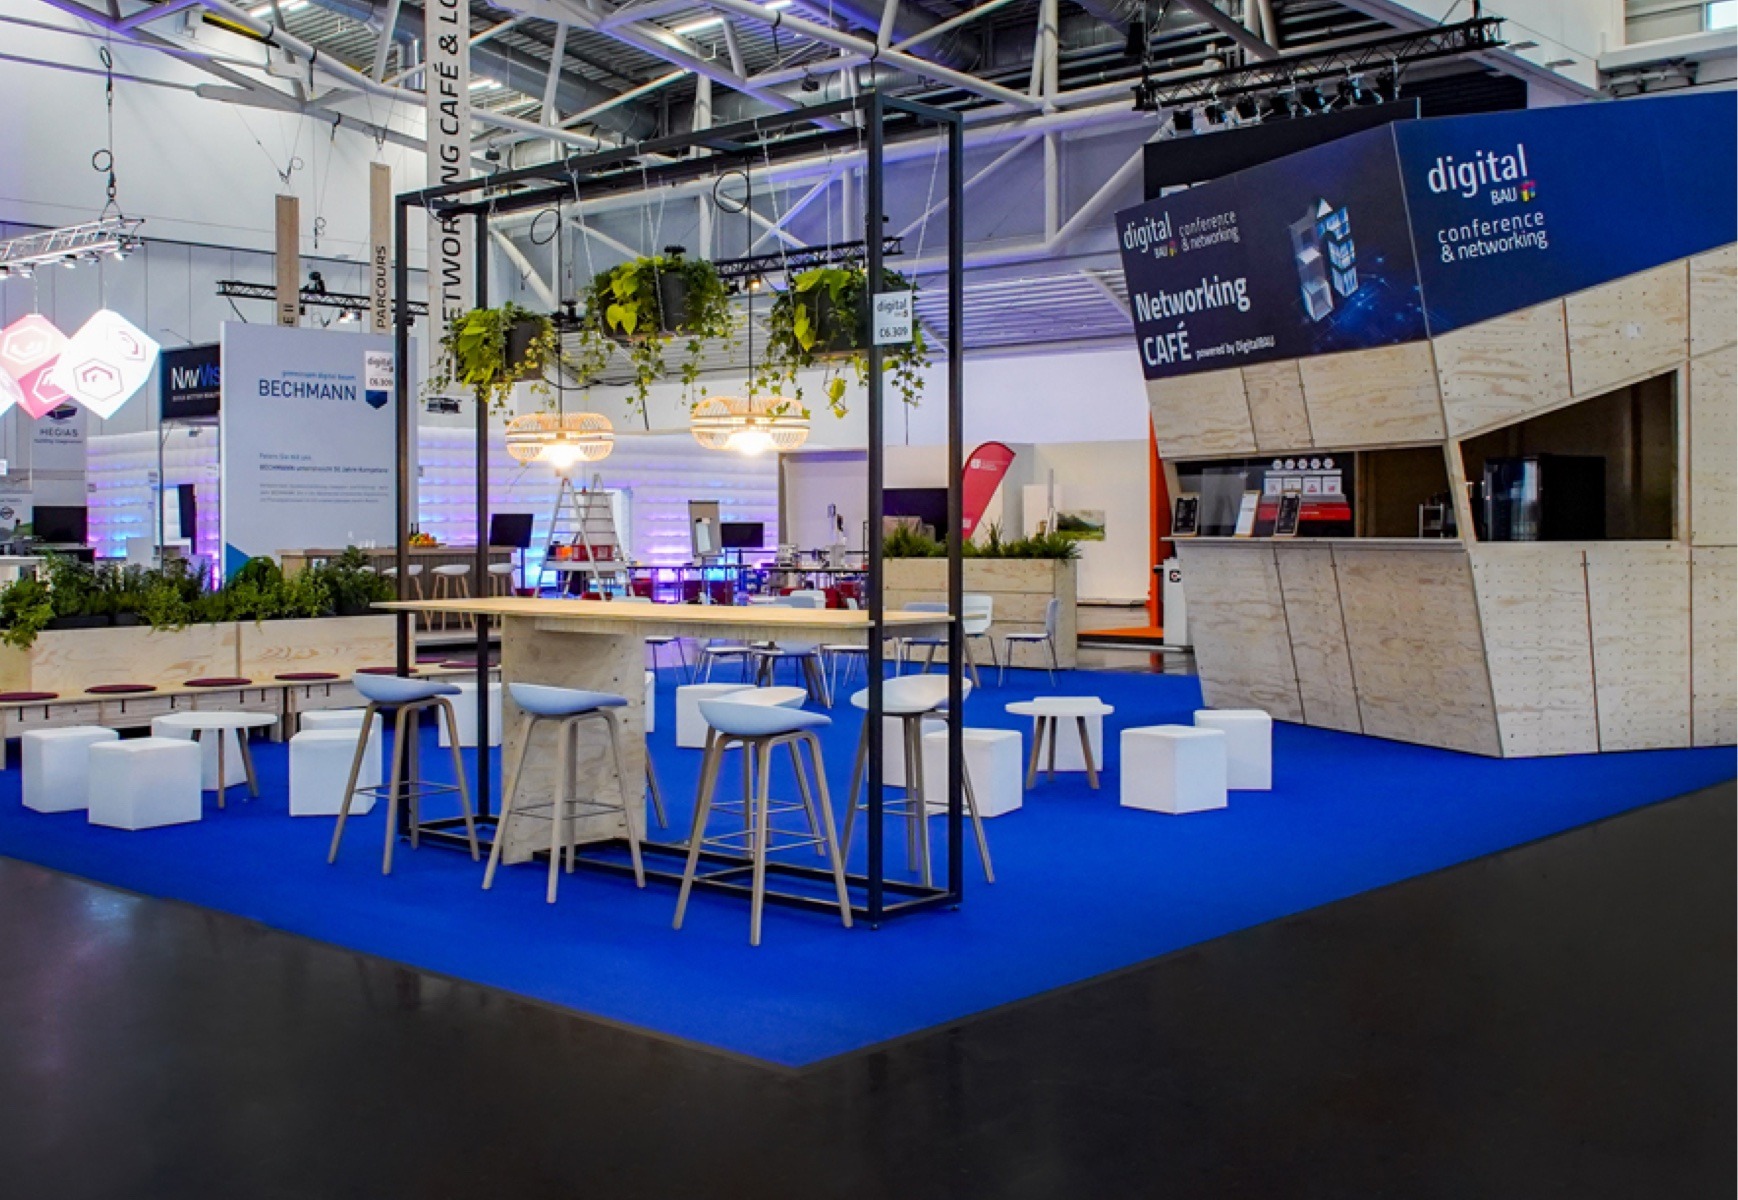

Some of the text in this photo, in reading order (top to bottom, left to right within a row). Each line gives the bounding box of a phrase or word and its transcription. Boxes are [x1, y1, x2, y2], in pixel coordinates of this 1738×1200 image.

[438, 34, 459, 55] &
[433, 61, 459, 136] CAFÉ
[1428, 143, 1528, 198] digital
[1490, 187, 1518, 205] BAU
[1123, 211, 1172, 253] digital
[1178, 211, 1236, 237] conference
[1190, 226, 1240, 249] networking
[1438, 211, 1544, 243] conference
[440, 144, 461, 341] ETWORNG
[1441, 230, 1549, 263] & networking
[374, 245, 387, 328] PARCOURS
[1134, 274, 1250, 322] Networking
[877, 298, 907, 313] digital
[1143, 321, 1192, 366] CAFÉ
[259, 379, 357, 401] BECHMANN
